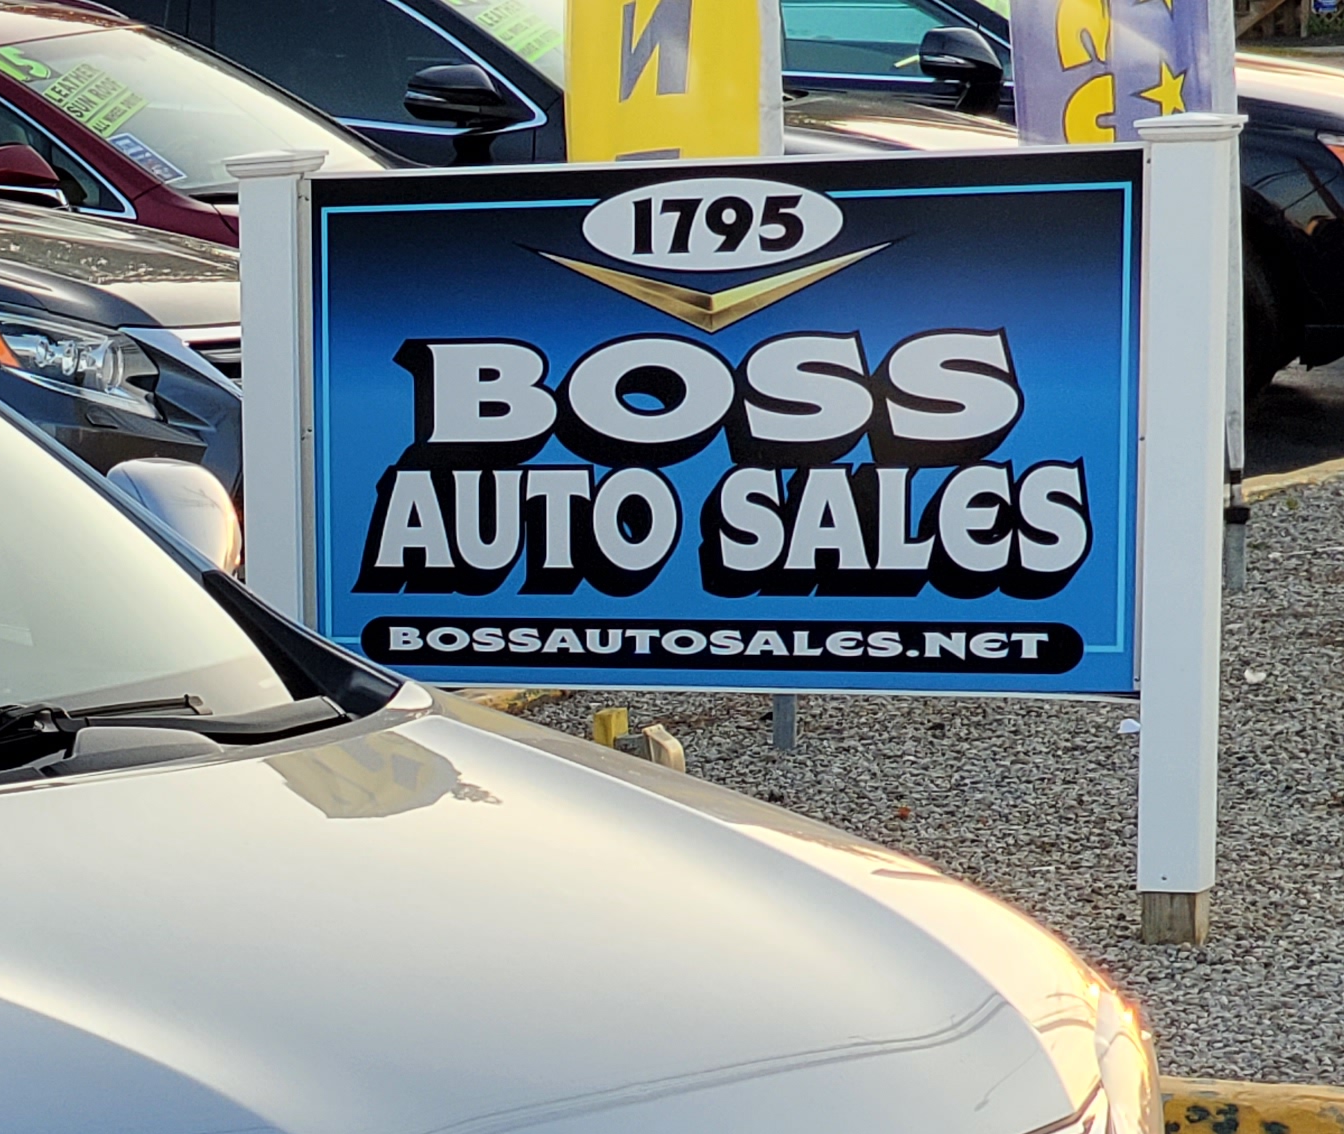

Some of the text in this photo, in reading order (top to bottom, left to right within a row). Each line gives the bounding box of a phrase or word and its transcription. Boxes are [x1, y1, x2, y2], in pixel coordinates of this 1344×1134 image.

[66, 95, 98, 119] SUN
[92, 120, 111, 135] ALL
[632, 195, 804, 255] 1795
[426, 330, 1020, 446] BOSS
[376, 464, 1089, 574] AUTO SALES
[388, 626, 1049, 662] BOSSAUTOSALES.NET
